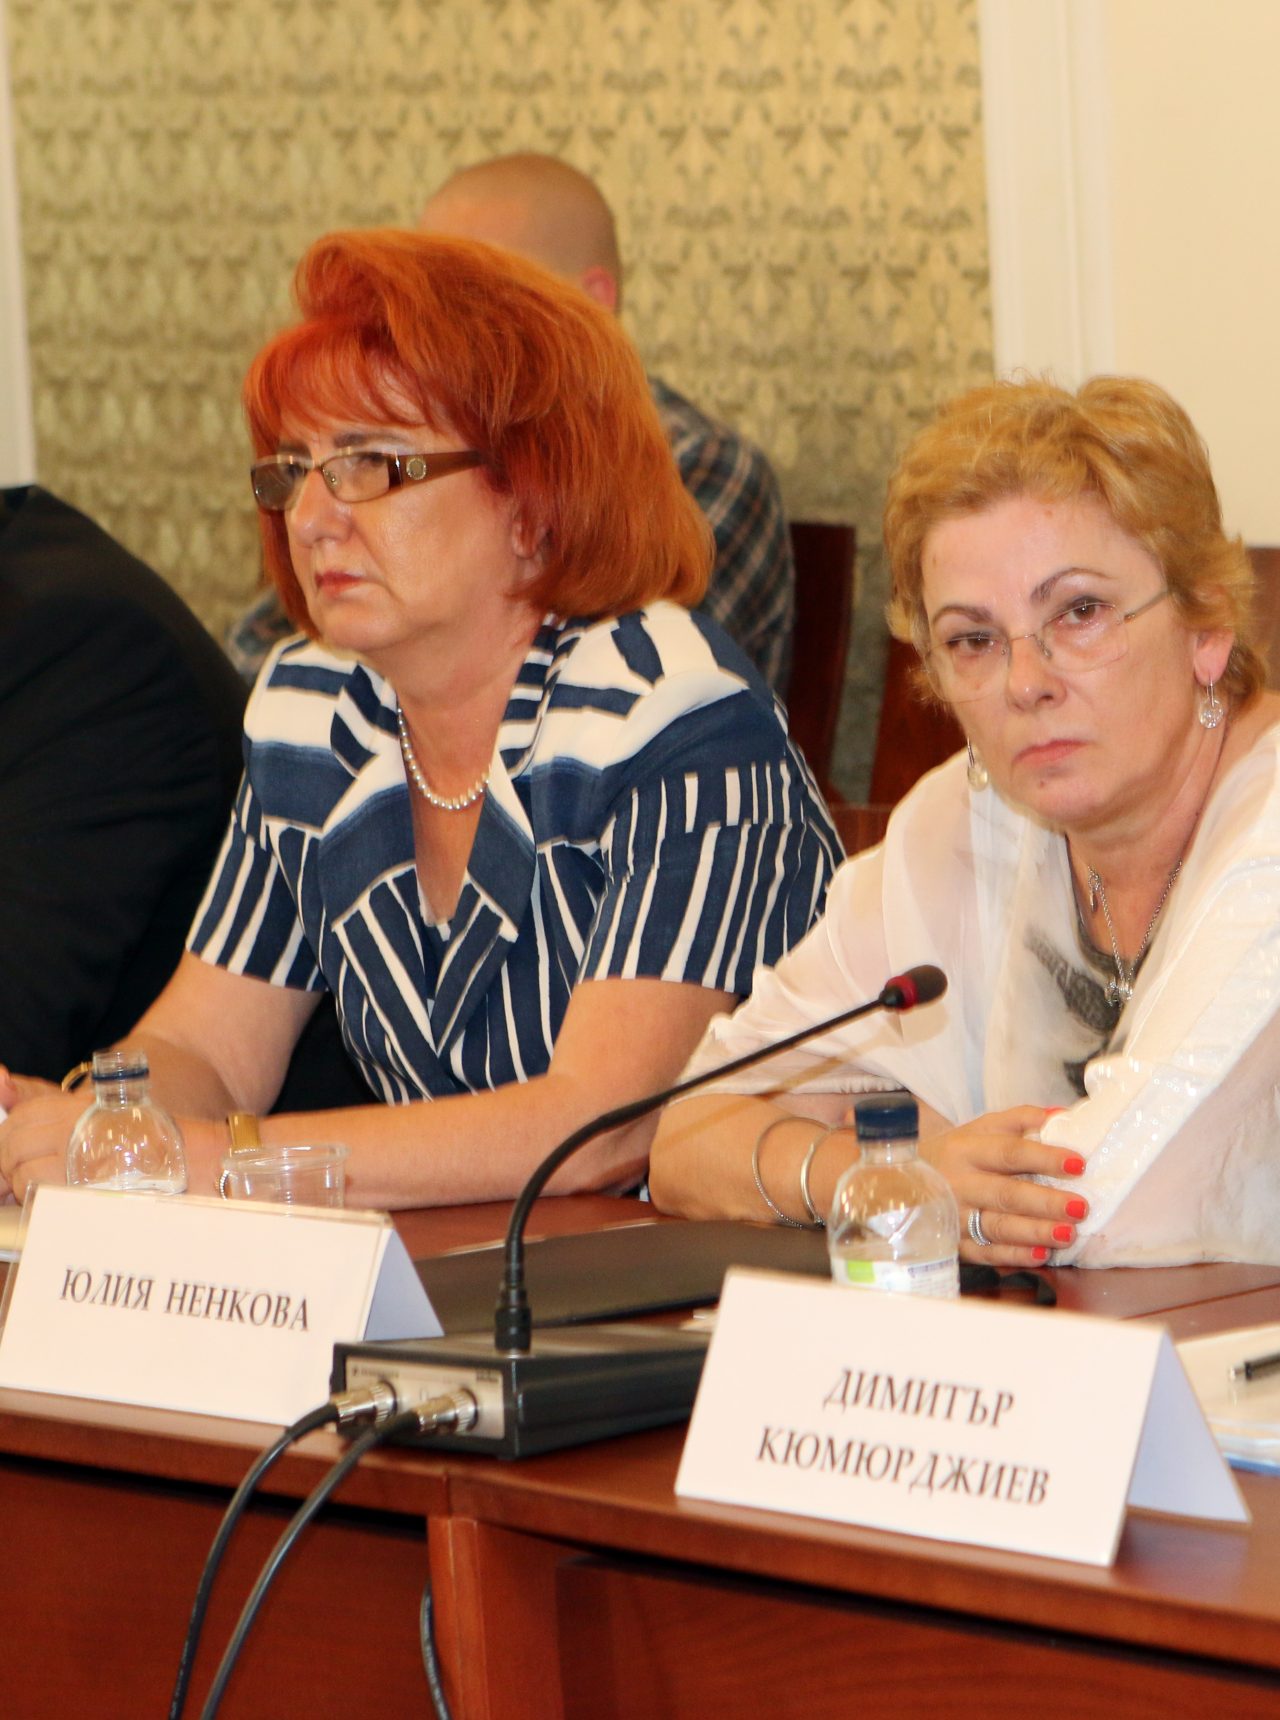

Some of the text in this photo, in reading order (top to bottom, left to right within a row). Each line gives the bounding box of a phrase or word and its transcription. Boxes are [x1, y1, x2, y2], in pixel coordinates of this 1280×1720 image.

[60, 1268, 309, 1331] ЮЛИЯ НЕНКОВА
[823, 1368, 1015, 1428] ДИМИТЪР
[756, 1426, 1050, 1506] КЮМЮРДЖИЕВ
